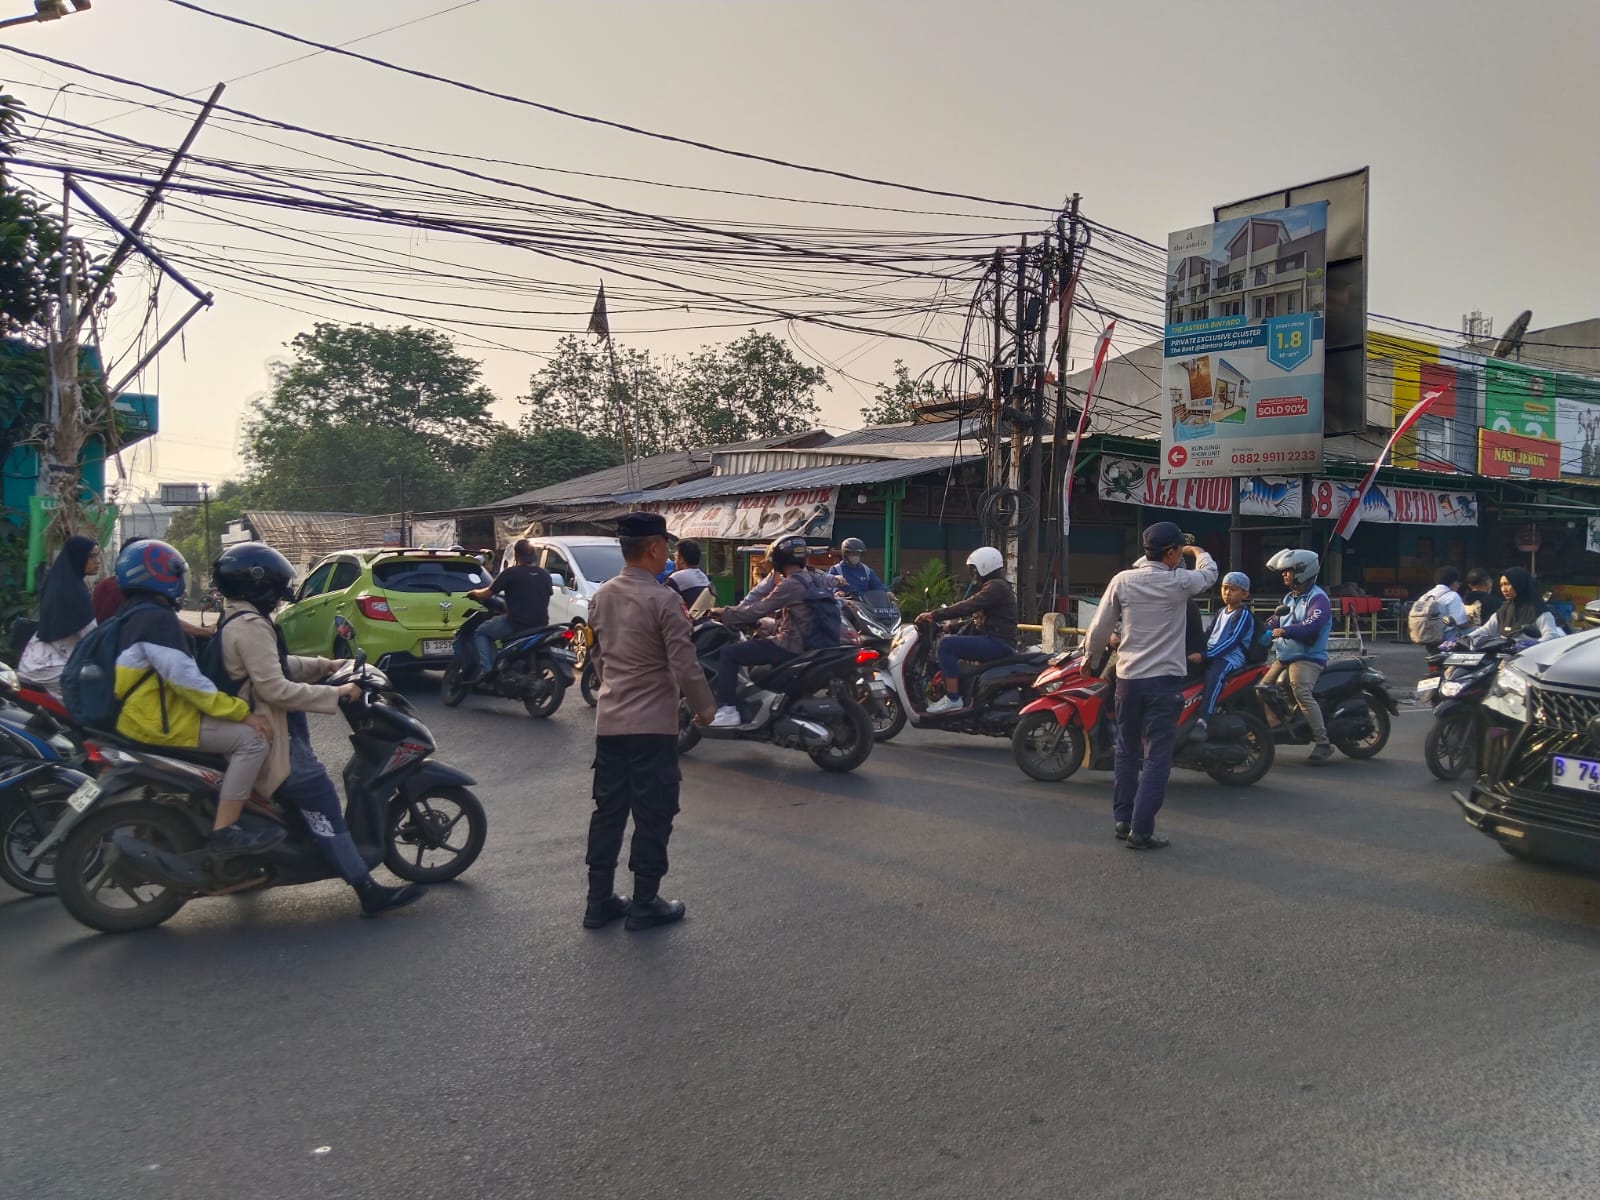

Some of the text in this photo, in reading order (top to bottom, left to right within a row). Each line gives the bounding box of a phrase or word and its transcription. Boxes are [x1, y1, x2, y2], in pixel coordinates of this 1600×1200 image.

[1210, 318, 1241, 328] BINTARO
[1171, 329, 1261, 347] PRIVATE EXCLUSIVE CLUSTER
[1276, 331, 1302, 350] 1.8
[1258, 404, 1306, 416] SOLD 90%
[1195, 459, 1214, 467] 2 KM
[1231, 449, 1316, 464] 0882 9911 2233
[1494, 447, 1545, 467] NASI JERUK
[784, 486, 833, 508] UDUK
[1143, 467, 1231, 512] SEA FOOD
[664, 500, 700, 515] FOOD
[1392, 489, 1438, 523] METRO
[1554, 758, 1566, 777] B
